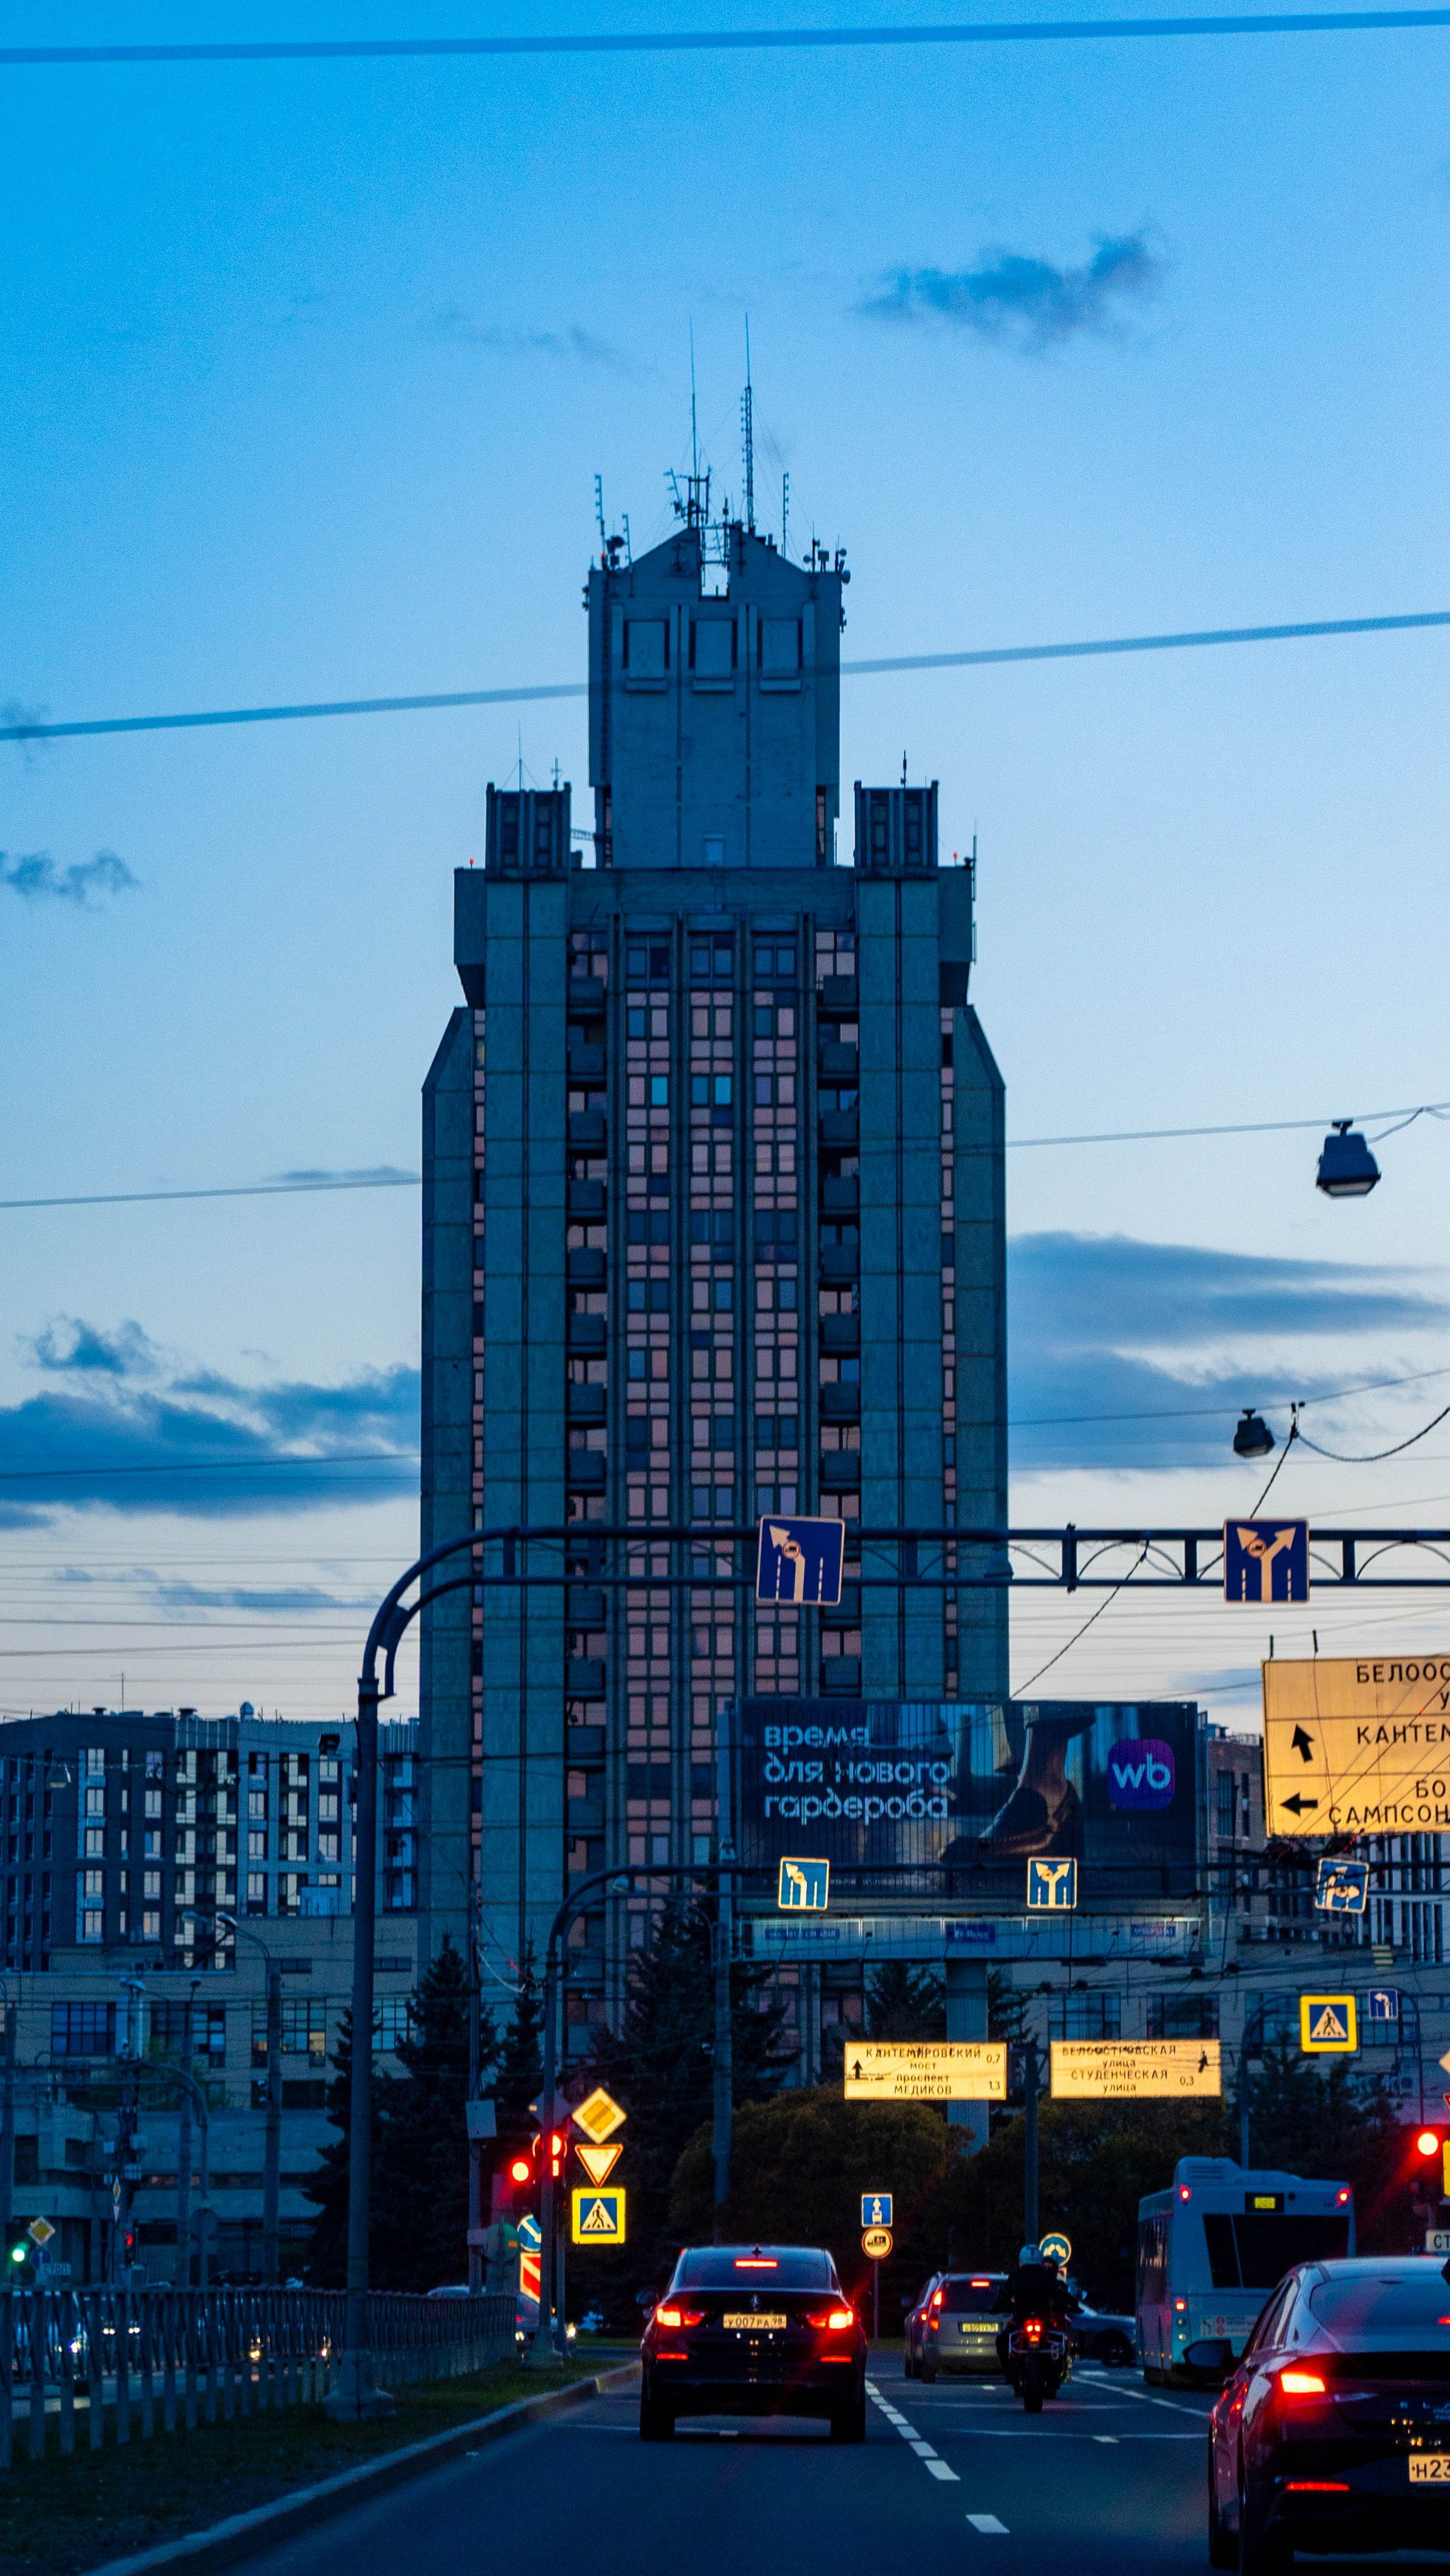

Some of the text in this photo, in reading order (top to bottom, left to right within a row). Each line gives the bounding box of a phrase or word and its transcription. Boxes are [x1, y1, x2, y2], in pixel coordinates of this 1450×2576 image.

[764, 1726, 870, 1755] время
[764, 1752, 951, 1784] для нового
[1112, 1752, 1171, 1790] wb
[764, 1786, 949, 1826] гардероба
[866, 2047, 1001, 2064] КАНТЕМИРОВСКИЙ 0,7
[1062, 2045, 1176, 2057] БЕЛООСТРОВСКАЯ
[1103, 2060, 1136, 2069] улица
[1071, 2070, 1168, 2081] СТУДЕНЧЕСКАЯ
[1180, 2077, 1195, 2086] 0,3
[896, 2075, 1001, 2091] проспект 1,3
[1103, 2084, 1136, 2094] улица
[894, 2085, 952, 2096] МЕДИКОВ
